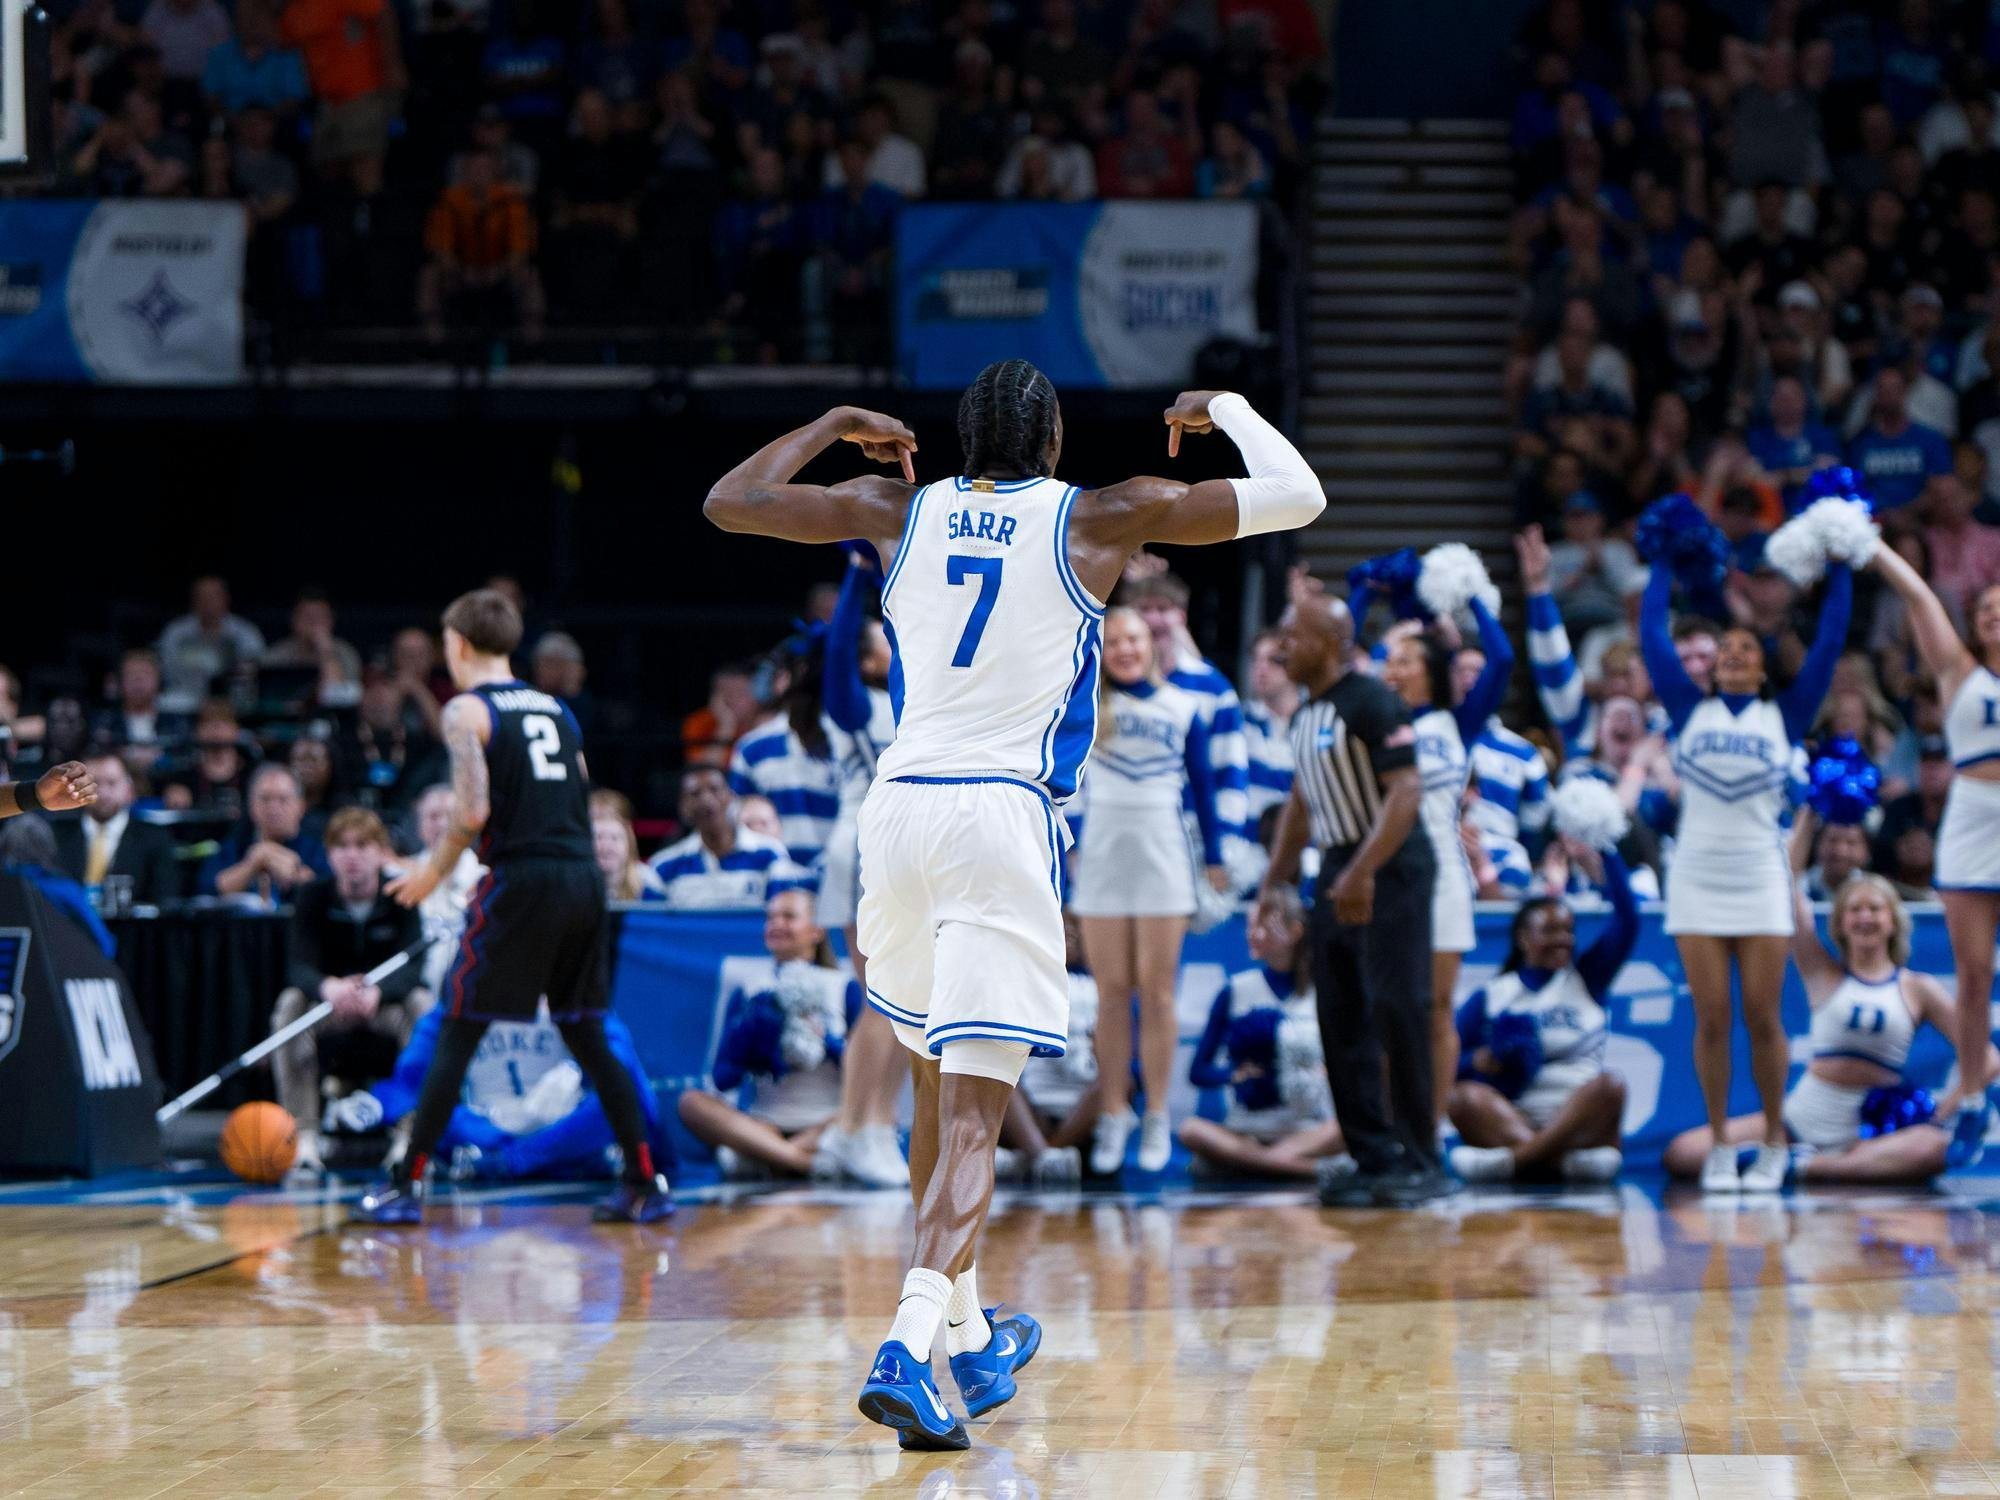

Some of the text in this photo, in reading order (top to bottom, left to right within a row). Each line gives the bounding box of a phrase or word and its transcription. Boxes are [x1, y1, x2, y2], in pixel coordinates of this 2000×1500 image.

[948, 510, 1017, 546] SARR
[946, 554, 1004, 668] 7
[522, 714, 568, 781] 2
